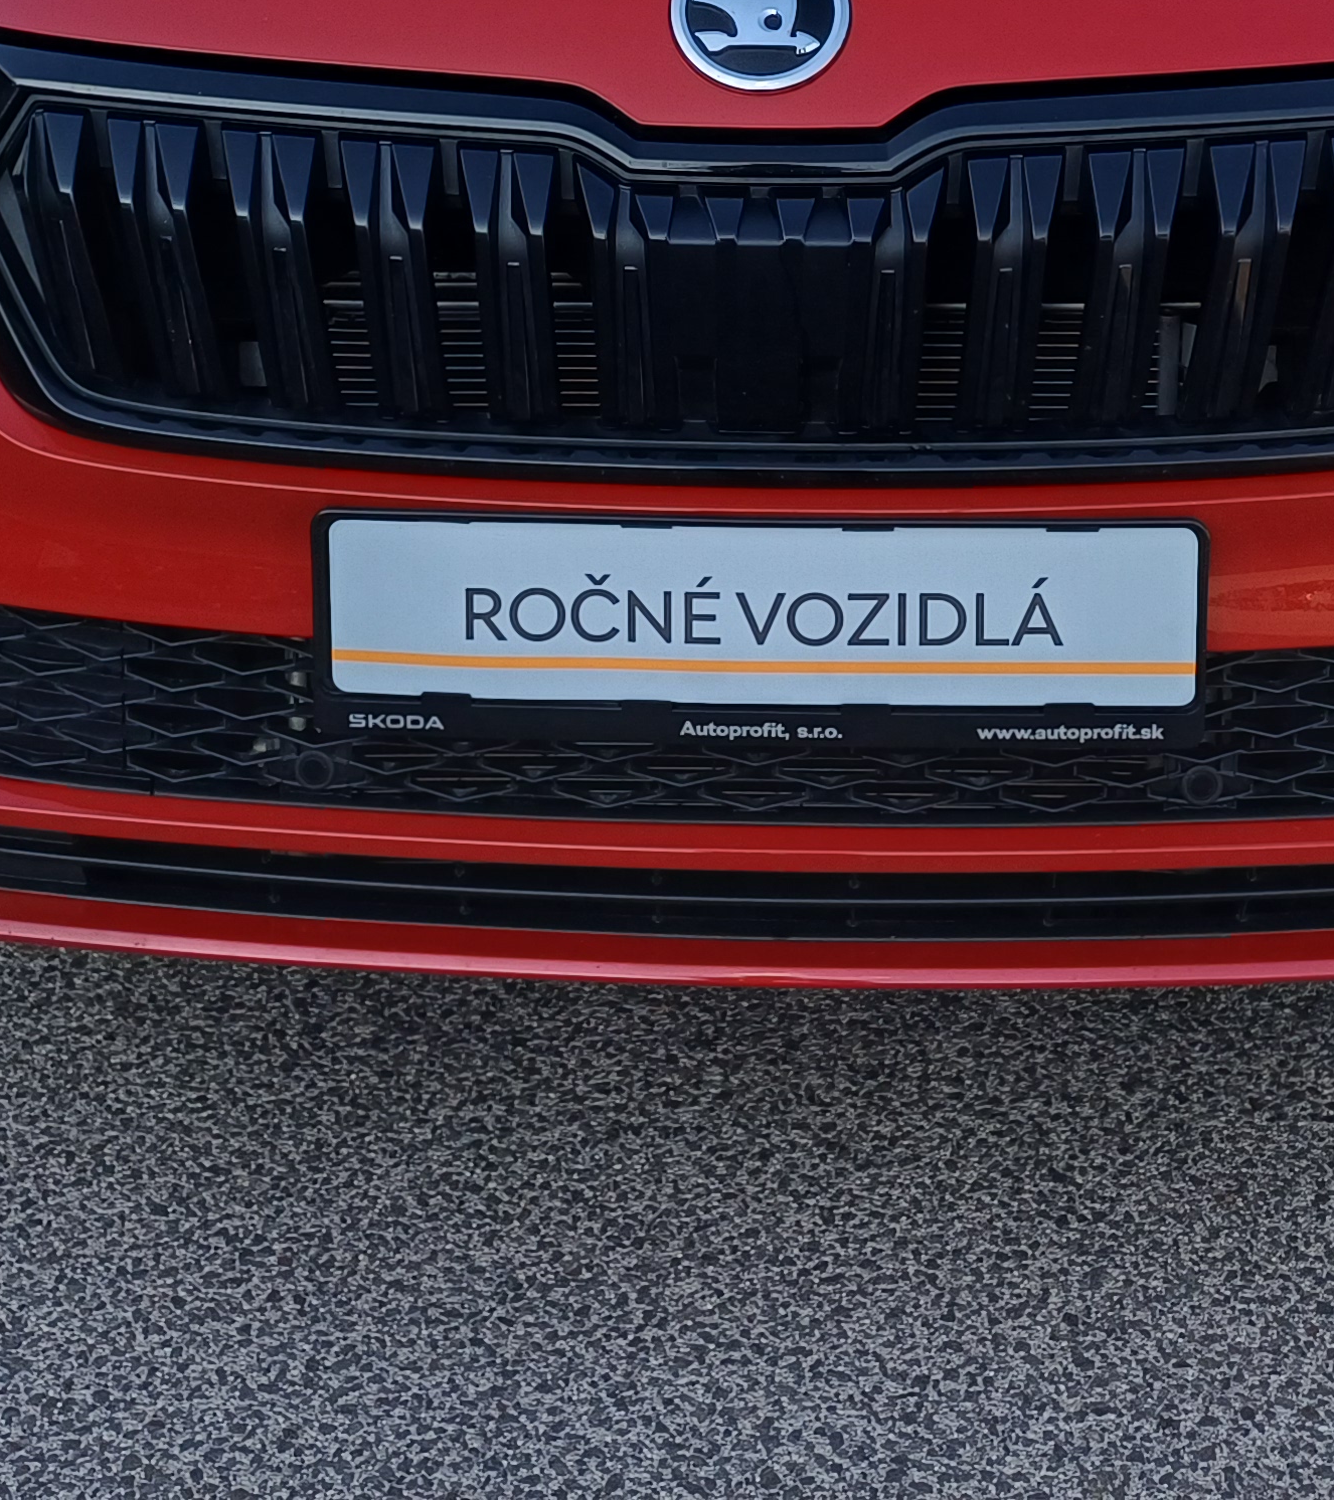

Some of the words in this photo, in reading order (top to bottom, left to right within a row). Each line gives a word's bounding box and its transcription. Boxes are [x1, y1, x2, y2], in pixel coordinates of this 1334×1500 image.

[465, 573, 722, 645] ROČNÉ
[736, 577, 1064, 647] VOZIDLÁ
[679, 720, 790, 741] Autoprofit,
[797, 726, 844, 739] s.r.o.
[976, 723, 1164, 743] www.autoprofit.sk
